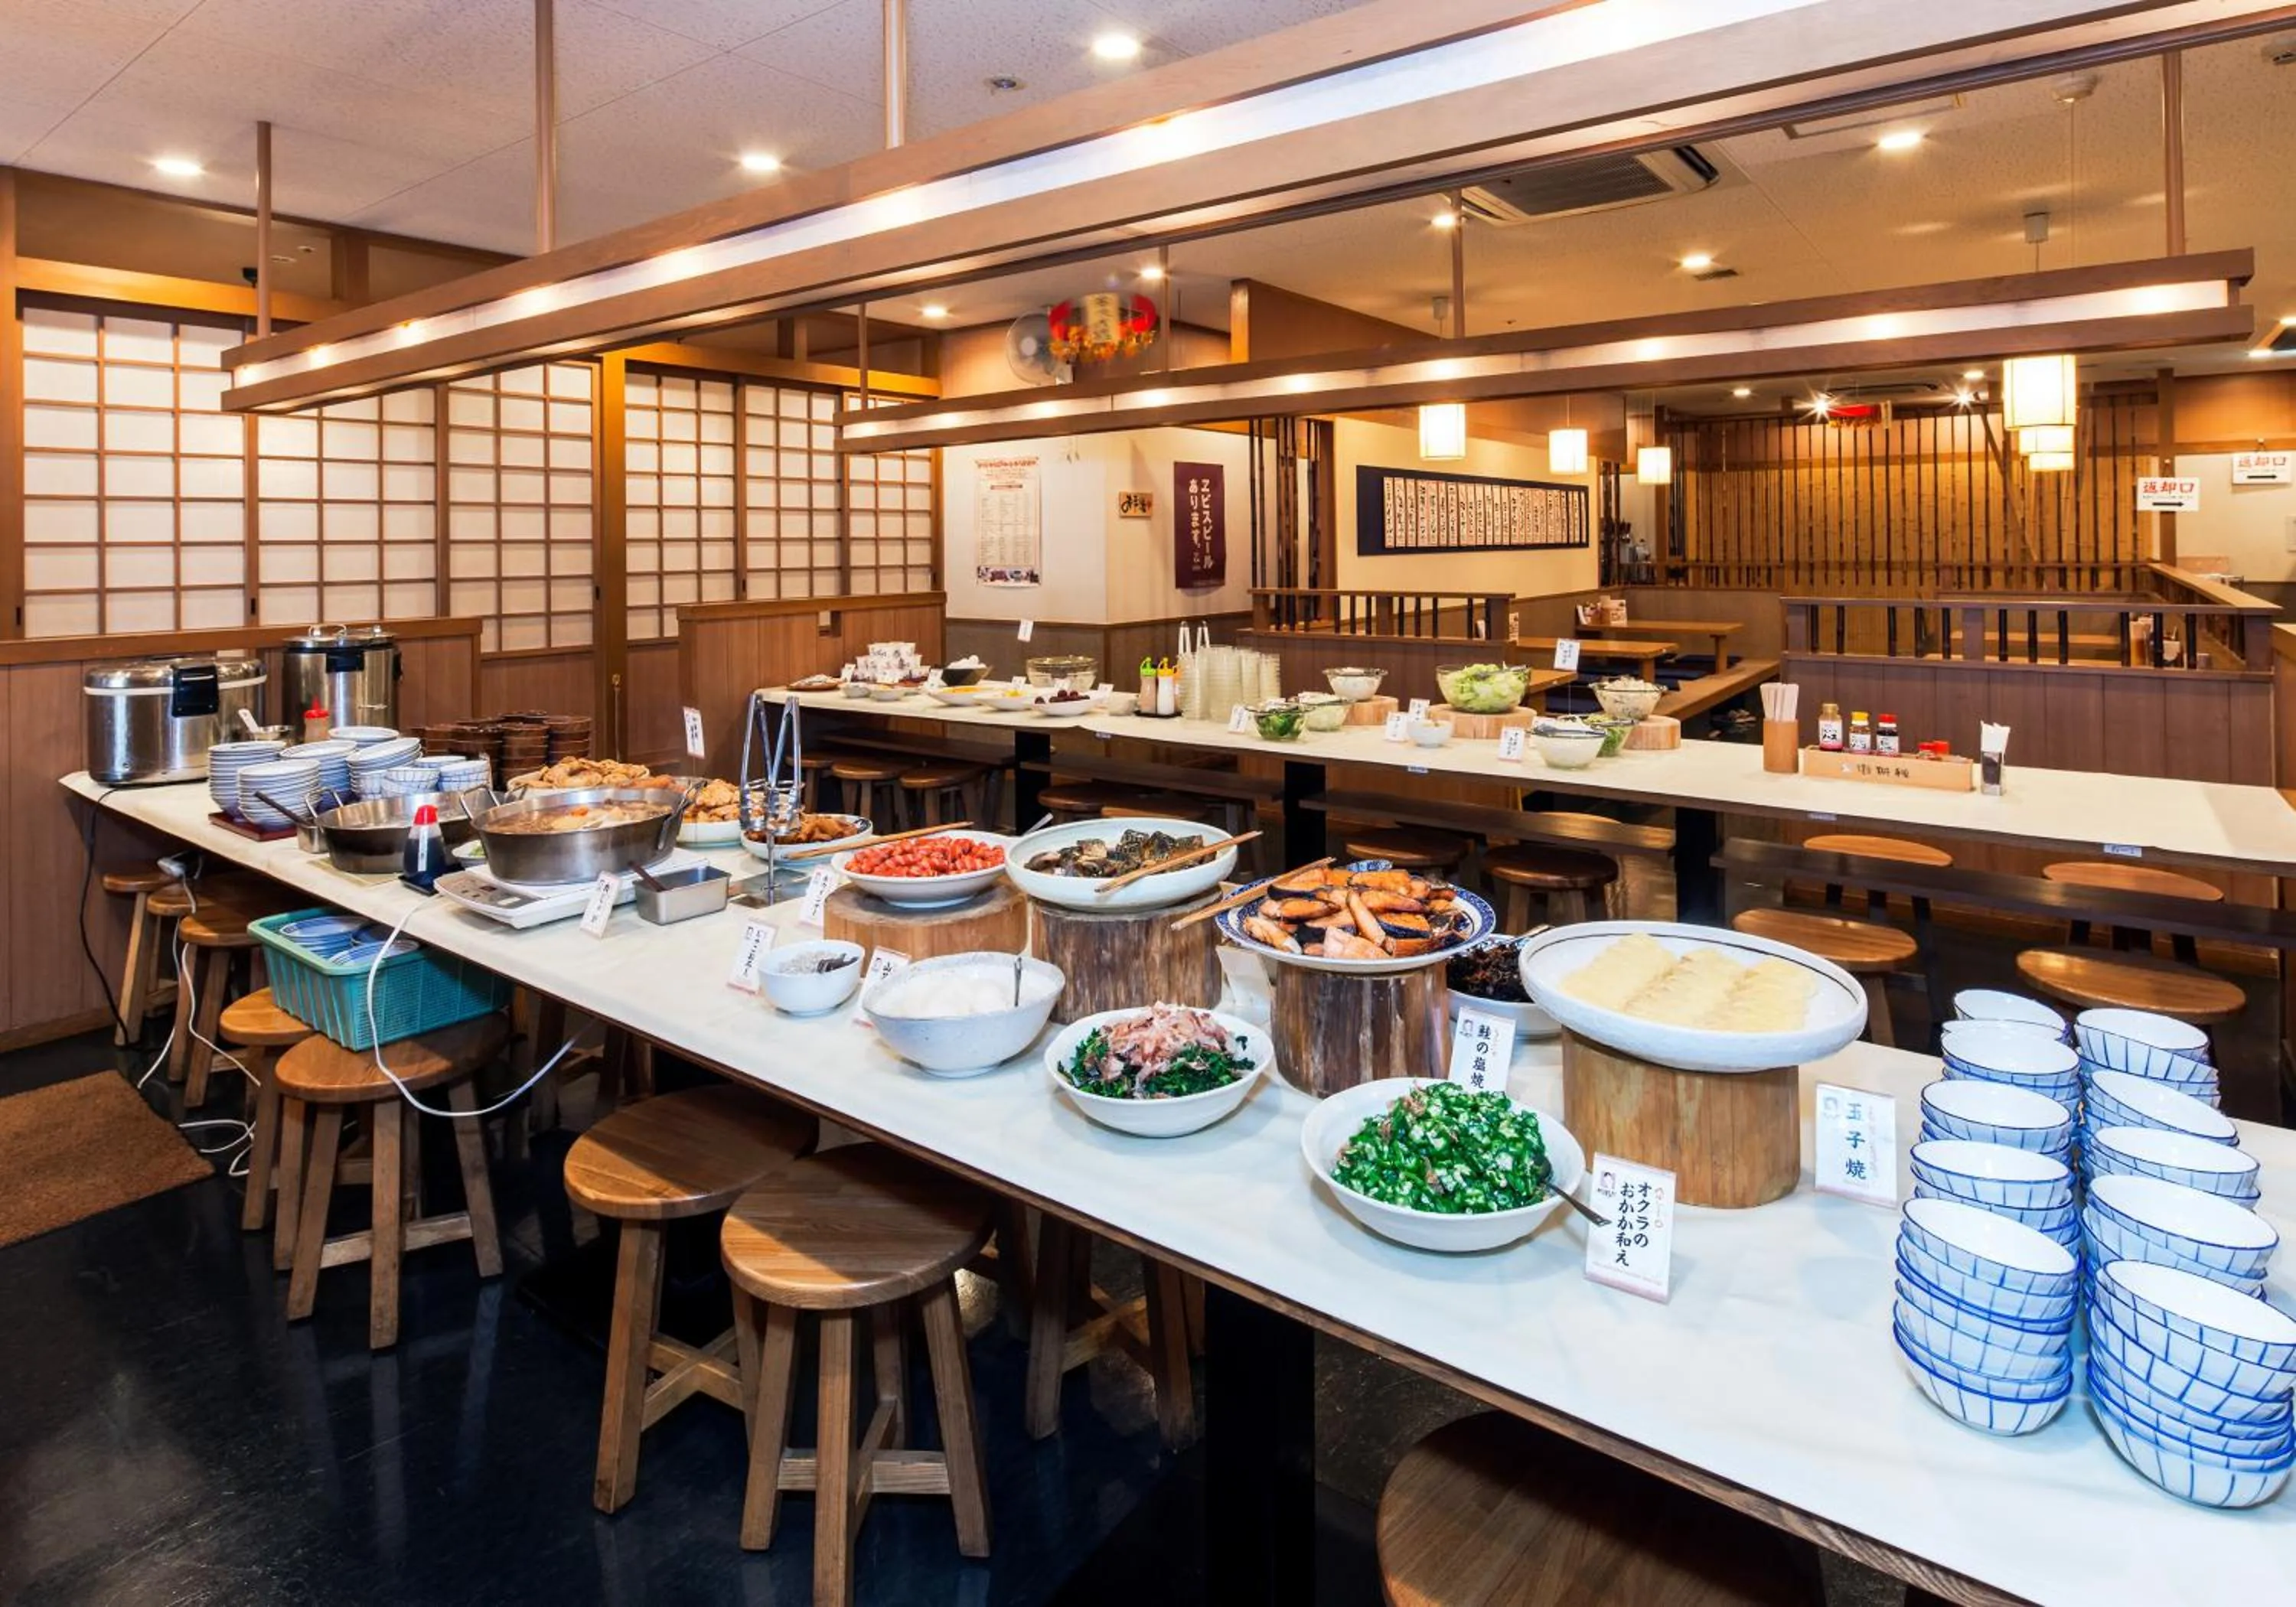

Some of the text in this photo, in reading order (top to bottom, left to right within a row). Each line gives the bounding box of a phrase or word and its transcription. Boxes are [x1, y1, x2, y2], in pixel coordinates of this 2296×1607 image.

[1189, 478, 1201, 549] あります。
[1471, 1025, 1491, 1089] 鮭の塩焼
[1845, 1103, 1867, 1180] 玉子焼
[1616, 1182, 1635, 1266] おかか和え
[1633, 1182, 1652, 1248] オクラの
